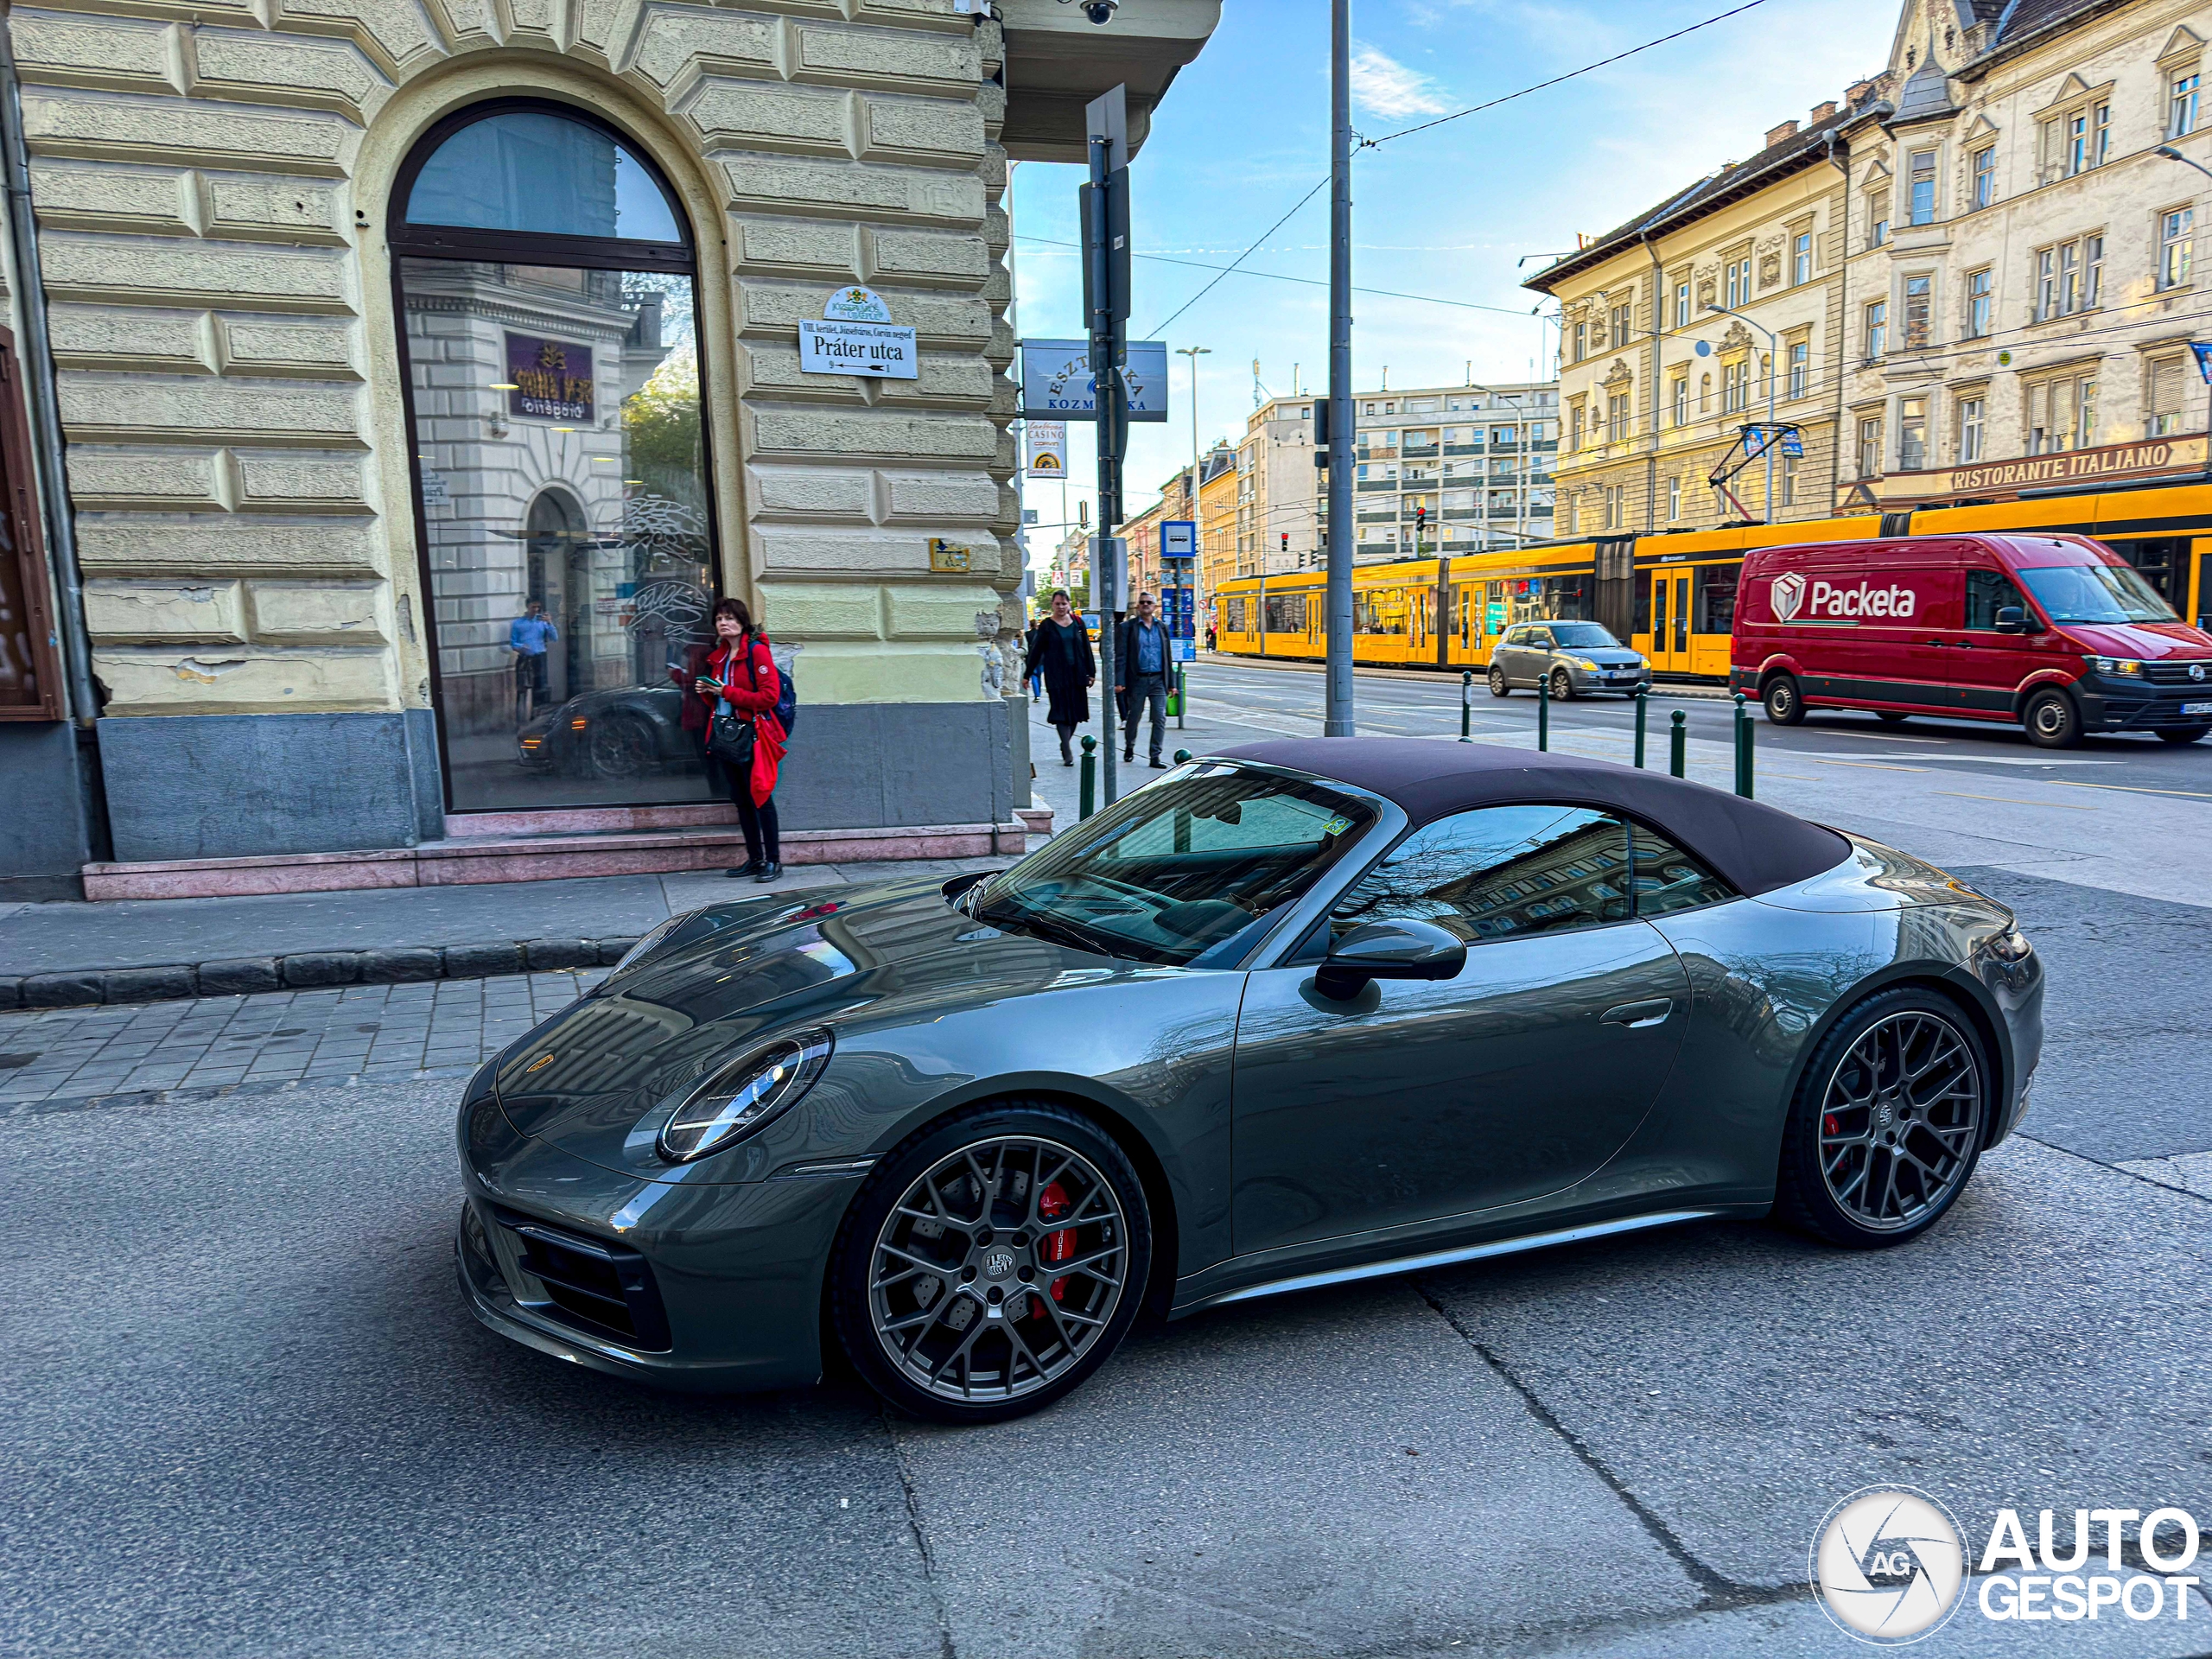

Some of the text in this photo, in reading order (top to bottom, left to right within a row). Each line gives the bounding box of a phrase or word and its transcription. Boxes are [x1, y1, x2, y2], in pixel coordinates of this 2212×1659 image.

[814, 335, 904, 360] Práter utca
[1048, 399, 1147, 410] KOZMKA
[1028, 430, 1065, 439] CASINO
[1954, 444, 2168, 489] RISTORANTE ITALIANO
[1810, 582, 1916, 617] Packeta
